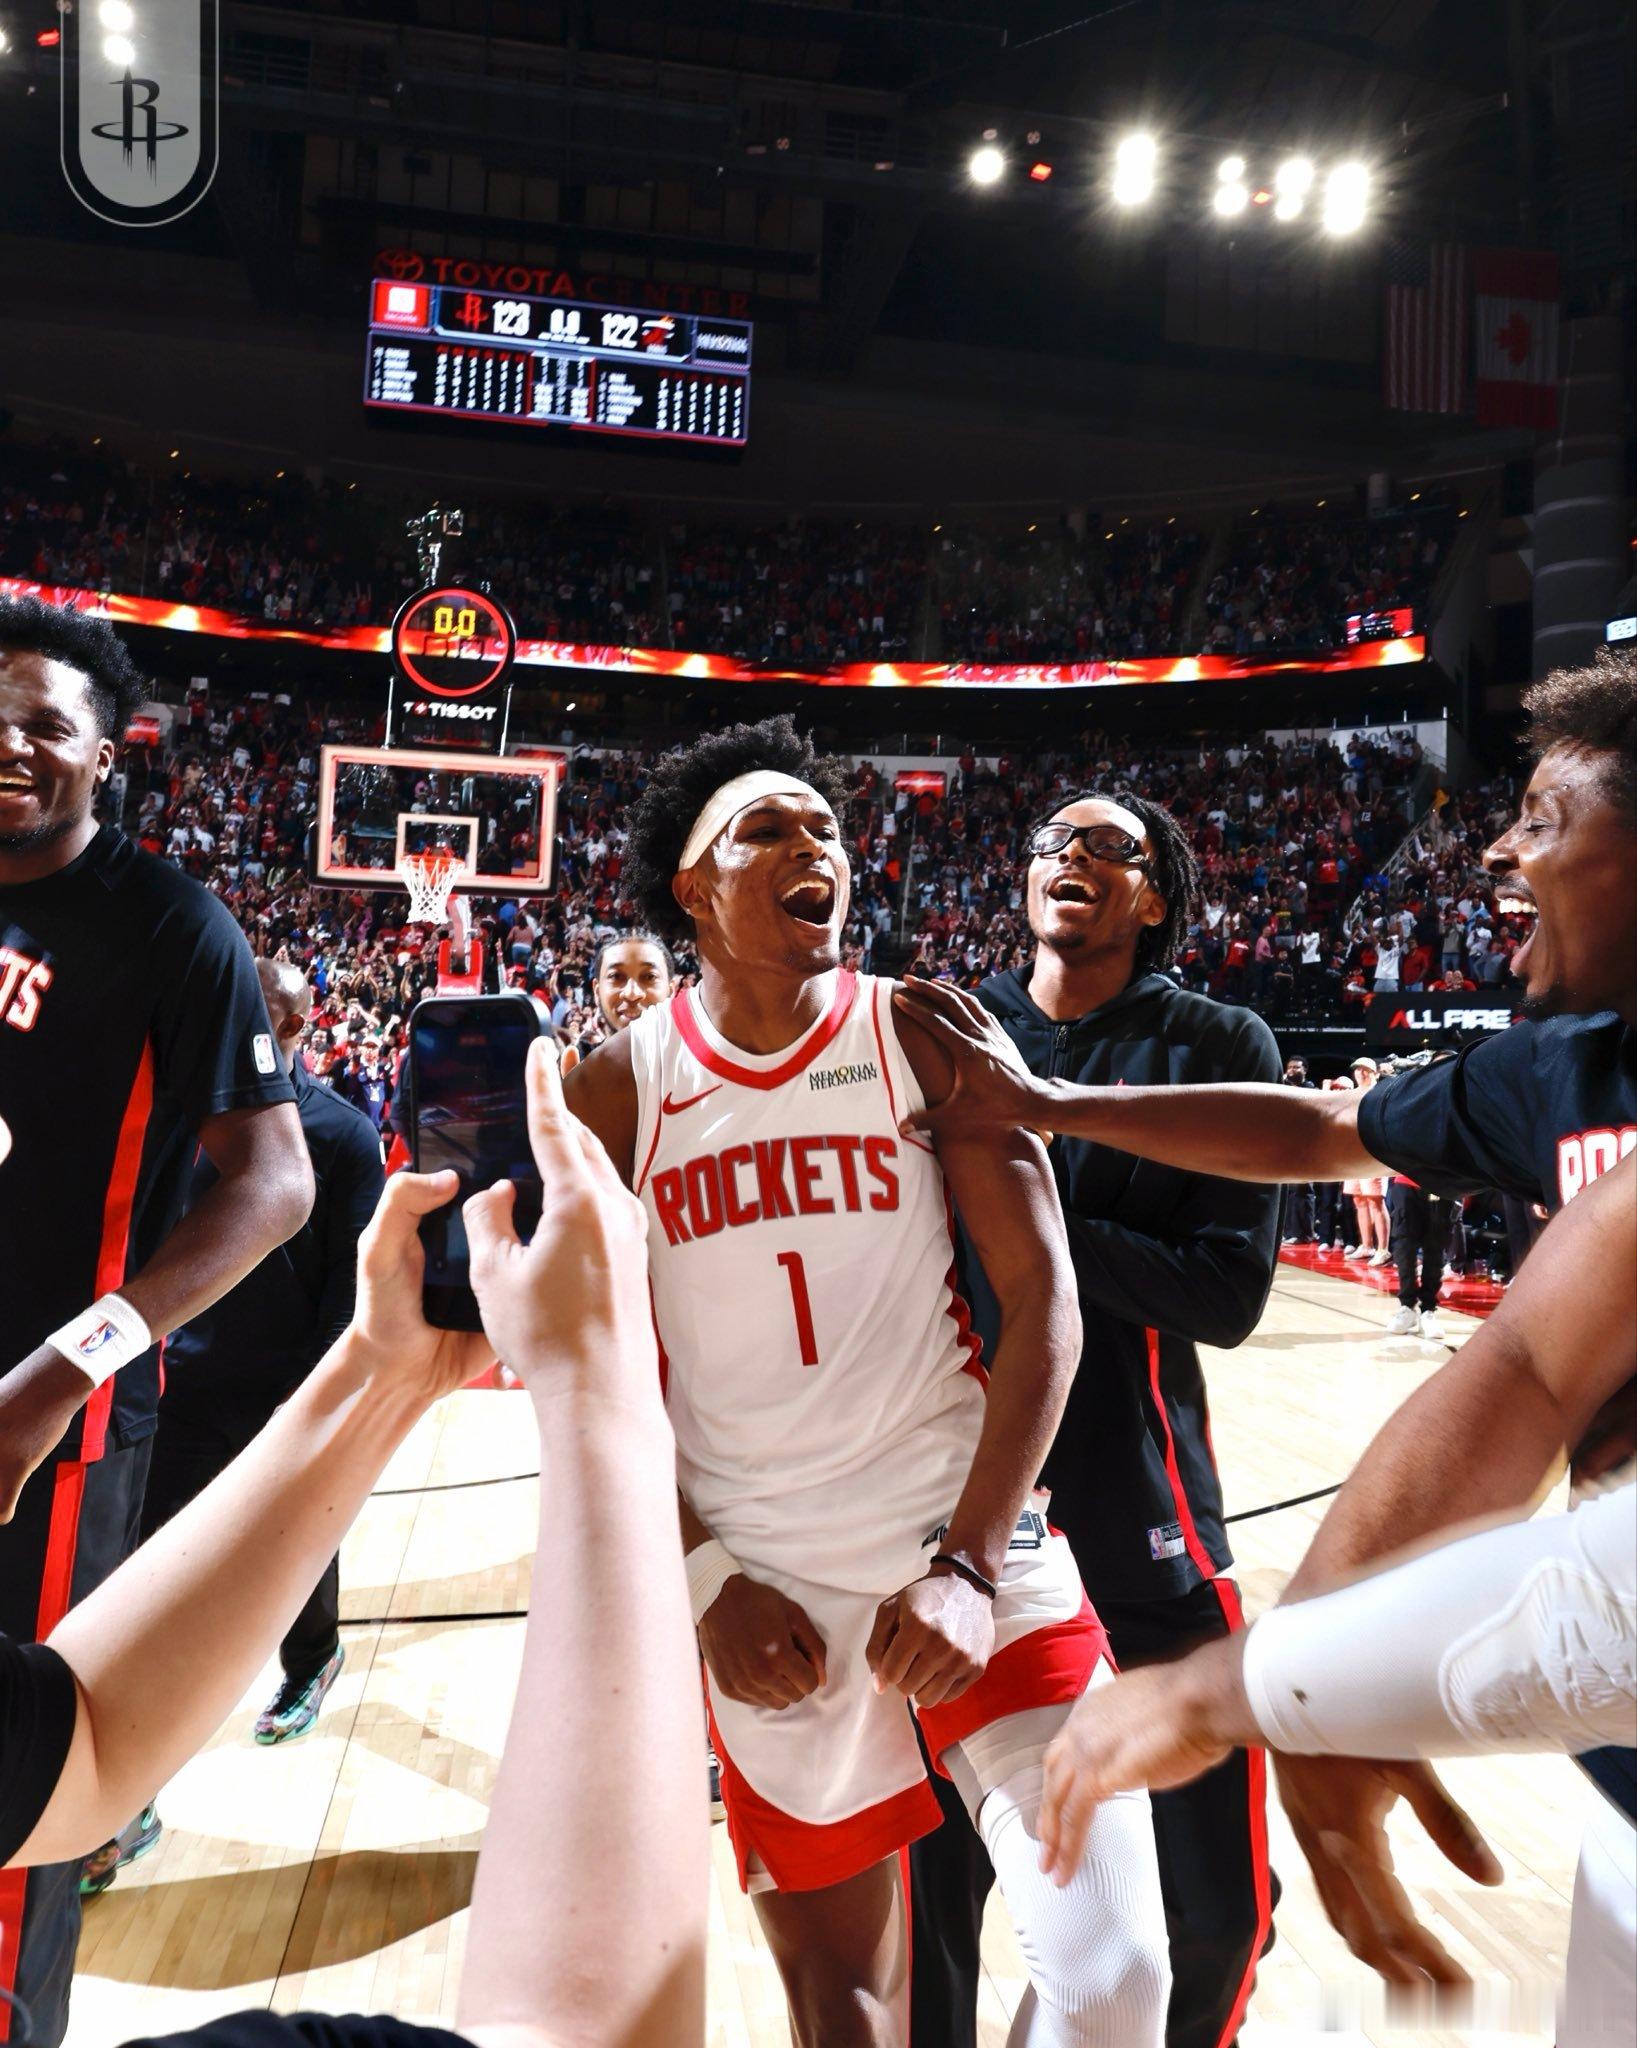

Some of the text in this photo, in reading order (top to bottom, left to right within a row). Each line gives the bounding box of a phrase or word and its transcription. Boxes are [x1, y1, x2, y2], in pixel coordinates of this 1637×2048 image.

[432, 257, 751, 318] TOYOTA CENTER
[492, 300, 531, 336] 123
[601, 312, 639, 349] 122
[434, 606, 476, 637] 0.0
[428, 702, 497, 721] TISSOT
[0, 946, 53, 1032] TS
[1389, 1009, 1512, 1031] ALL FIRE
[809, 1062, 876, 1081] MEMORIAL
[810, 1067, 878, 1091] HERMANN
[651, 1134, 900, 1248] ROCKETS
[777, 1251, 819, 1366] 1
